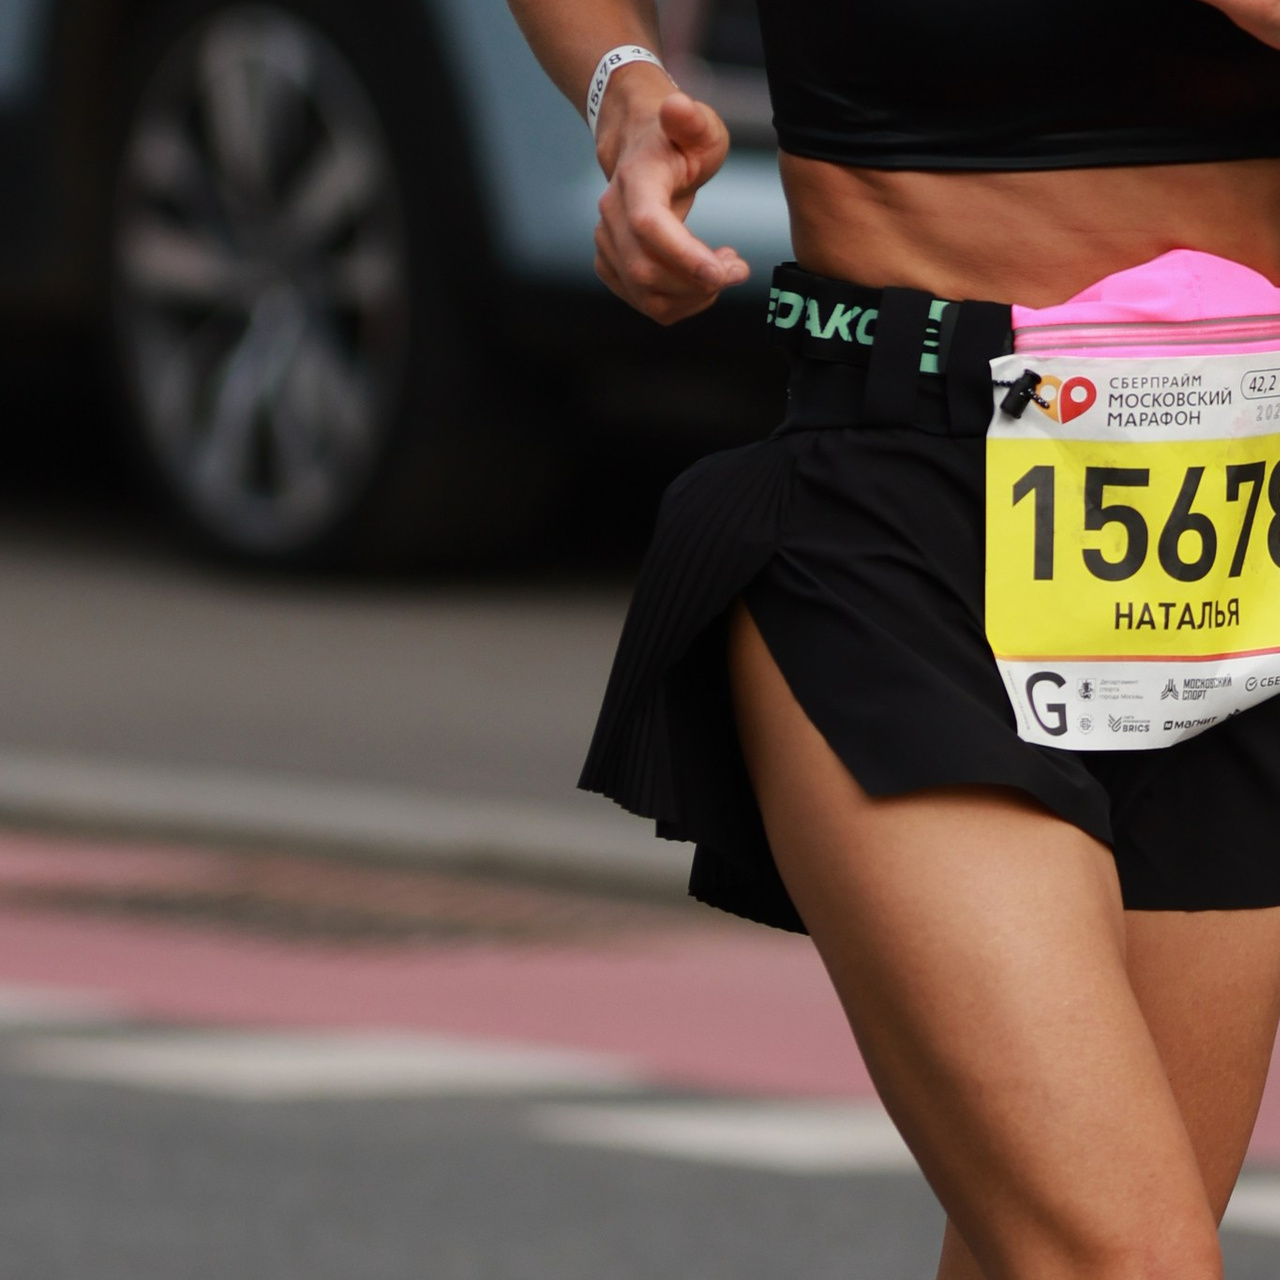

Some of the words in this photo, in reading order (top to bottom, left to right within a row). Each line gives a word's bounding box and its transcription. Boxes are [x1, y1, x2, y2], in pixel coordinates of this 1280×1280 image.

[588, 53, 622, 117] 15678
[1109, 373, 1202, 389] СБЕРПРАЙМ
[1249, 375, 1276, 394] 42,2
[1108, 387, 1232, 408] МОСКОВСКИЙ
[1107, 410, 1201, 427] МАРАФОН
[1114, 597, 1240, 631] НАТАЛЬЯ
[1183, 674, 1232, 689] МОСКОВСКИЙ
[1025, 671, 1068, 737] G
[1182, 690, 1207, 701] СПОРТ
[1122, 724, 1150, 732] BRICS
